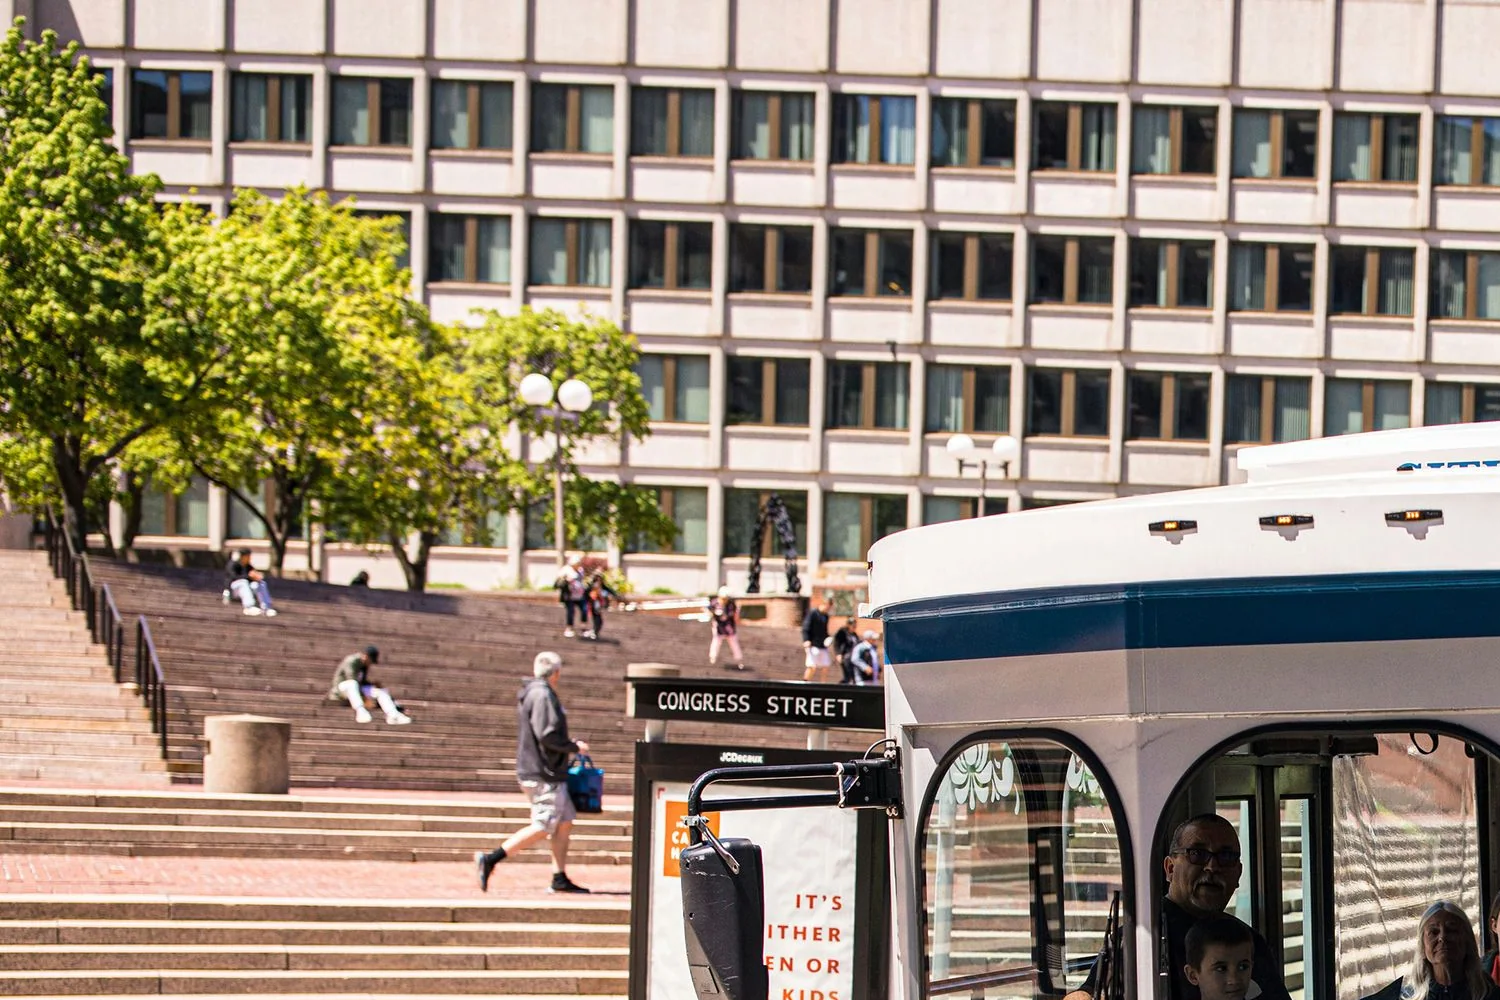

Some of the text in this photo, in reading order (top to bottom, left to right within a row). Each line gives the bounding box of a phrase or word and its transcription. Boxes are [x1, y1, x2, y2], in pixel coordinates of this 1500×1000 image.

[657, 691, 853, 718] CONGRESS STREET
[719, 751, 764, 764] JCDecaux
[795, 893, 842, 911] IT'S
[767, 924, 841, 942] ITHER
[765, 956, 840, 974] EN OR
